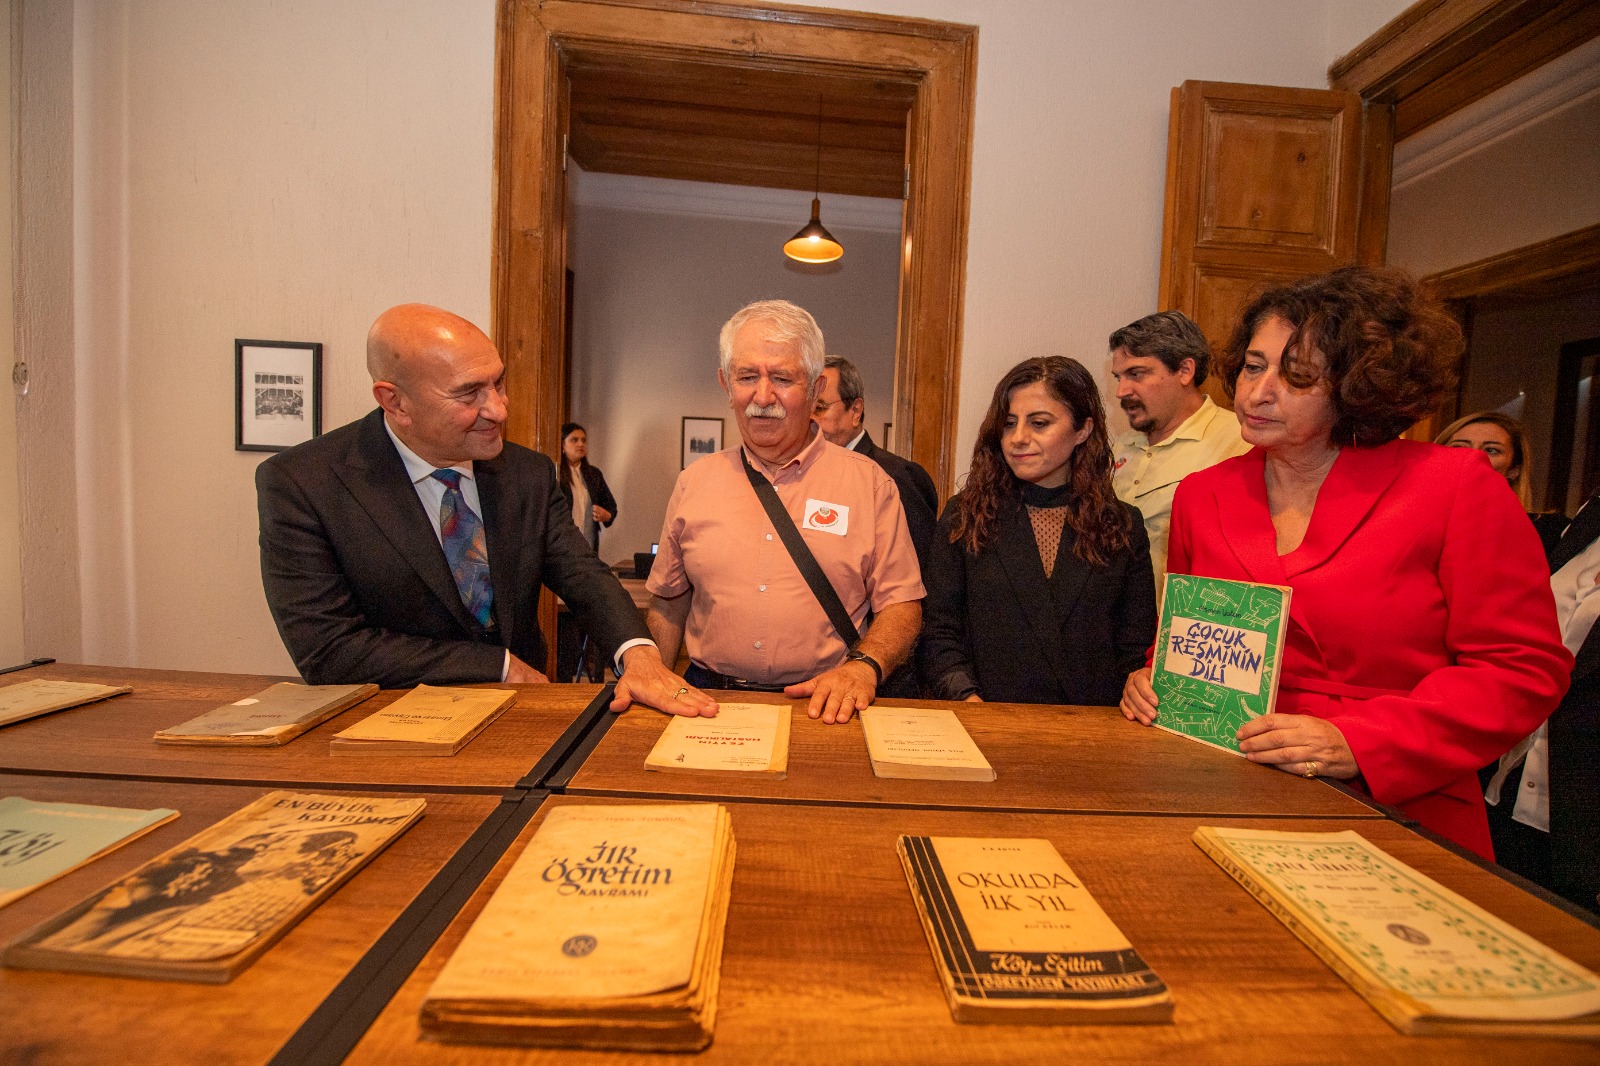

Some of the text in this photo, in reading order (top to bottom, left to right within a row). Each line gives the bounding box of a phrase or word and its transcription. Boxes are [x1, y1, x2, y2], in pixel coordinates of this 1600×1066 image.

[1187, 622, 1246, 649] ÇOCUK
[1171, 635, 1261, 674] RESMİNİN
[1188, 658, 1225, 684] DİLİ
[273, 799, 378, 813] EN BÜYÜK
[957, 872, 1079, 889] OKULDA
[979, 890, 1076, 911] İLK YIL
